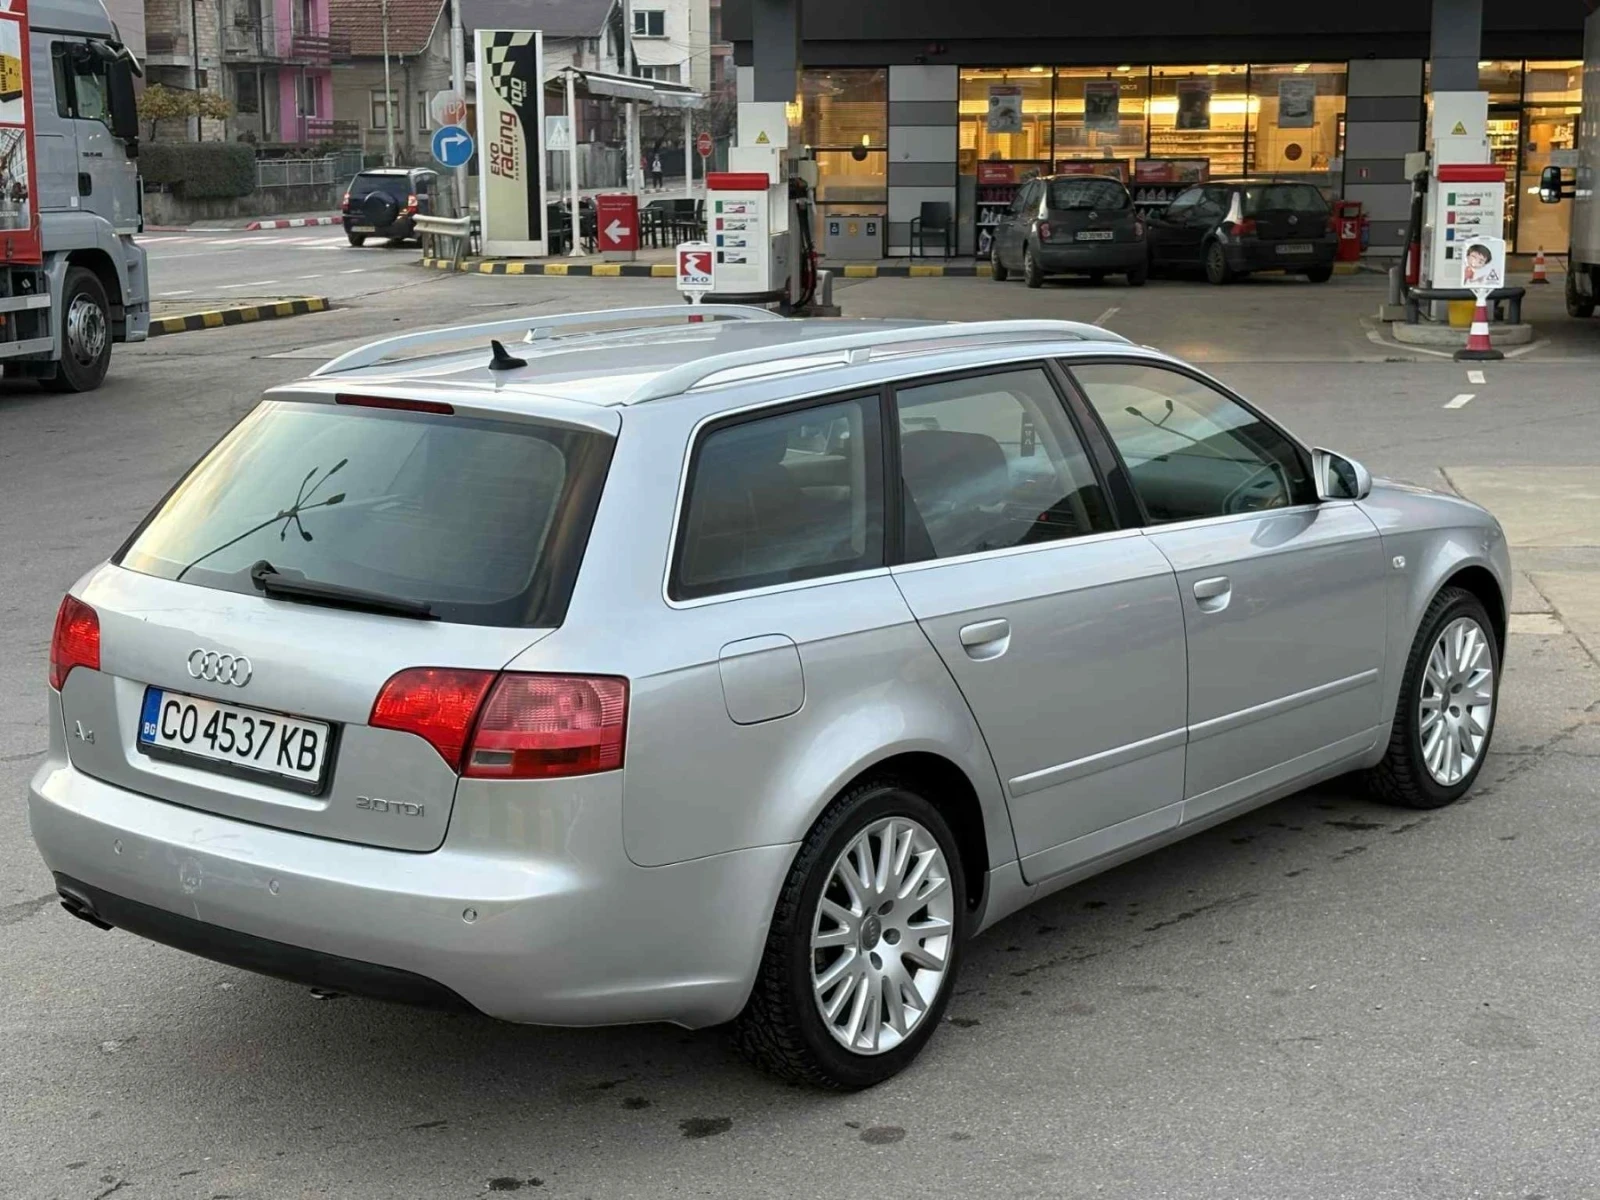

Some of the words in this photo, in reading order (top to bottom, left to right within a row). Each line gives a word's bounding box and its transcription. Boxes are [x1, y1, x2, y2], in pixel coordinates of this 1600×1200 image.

[510, 77, 523, 107] 100
[490, 142, 501, 176] EKO
[500, 111, 518, 180] racing
[75, 720, 96, 745] A4
[144, 721, 156, 736] BG
[161, 700, 198, 744] CO
[202, 710, 276, 760] 4537
[276, 724, 318, 772] KB
